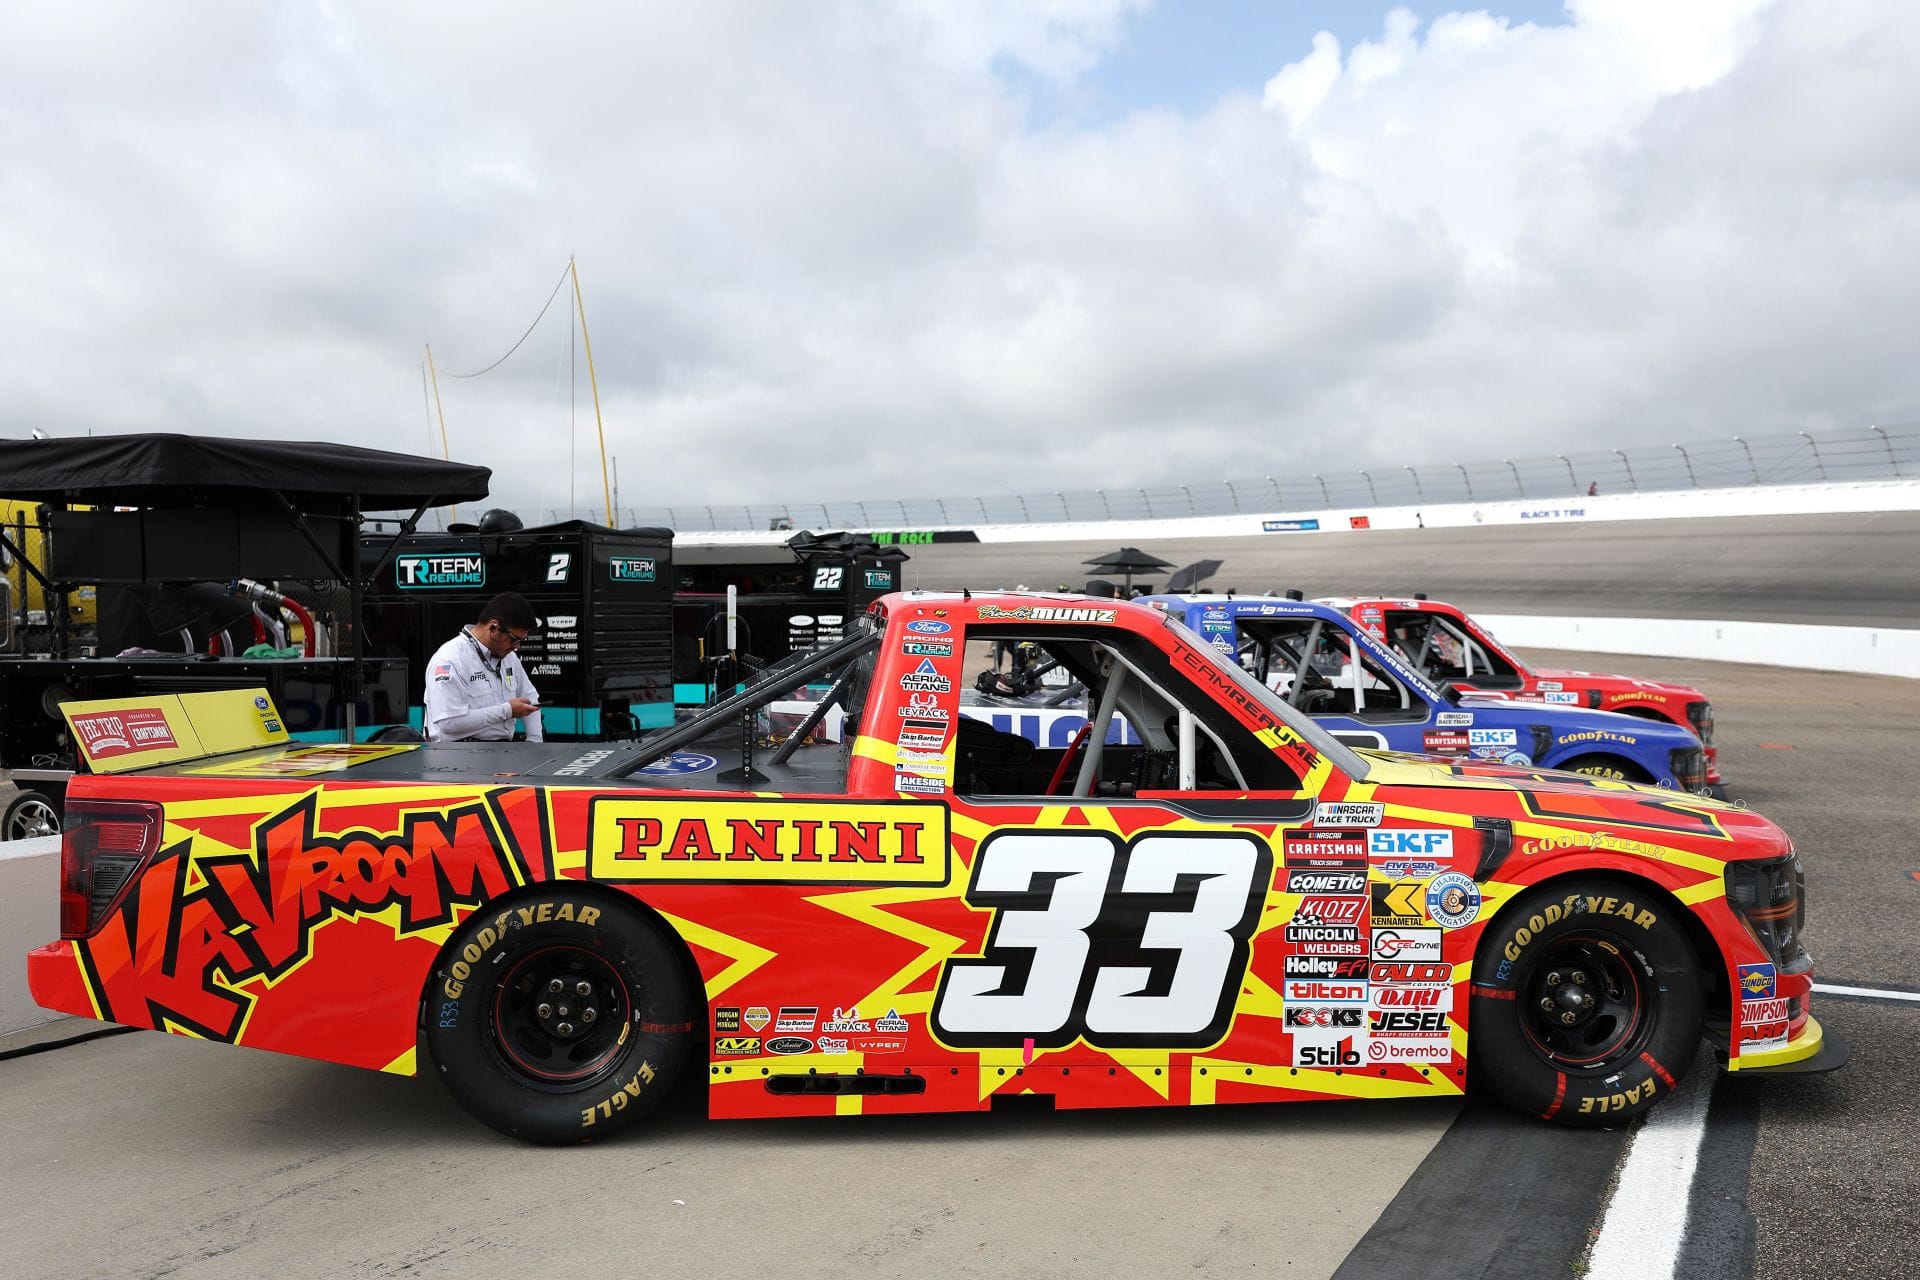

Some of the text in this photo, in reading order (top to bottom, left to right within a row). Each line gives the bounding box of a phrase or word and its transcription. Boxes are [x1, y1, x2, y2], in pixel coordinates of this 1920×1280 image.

[1520, 509, 1586, 519] BLACK'S TIRE
[871, 531, 934, 544] THE ROCK
[429, 558, 482, 573] TEAM
[547, 553, 570, 582] 2
[627, 560, 654, 572] TEAM
[429, 573, 482, 584] REAUME
[813, 567, 843, 589] 22
[1029, 607, 1118, 623] MUNIZ
[914, 621, 943, 632] Ford
[922, 644, 951, 652] TEAM
[1355, 629, 1441, 703] TEAMREAUME
[902, 674, 950, 684] AERIAL
[902, 682, 949, 692] TITANS
[1173, 640, 1322, 770] TEAMREAUME
[1547, 694, 1576, 702] SKF
[1610, 691, 1667, 703] GOODYEAR
[899, 708, 947, 718] LEVRACK
[74, 716, 126, 744] THE TRIP
[132, 726, 170, 741] CRAFTSMAN
[900, 733, 916, 741] Skip
[1471, 731, 1514, 744] SKF
[1558, 730, 1637, 745] GOODYEAR
[1425, 737, 1467, 745] CRAFTSMAN
[553, 750, 616, 776] RACING
[895, 774, 945, 791] LAKESIDE
[1335, 805, 1375, 815] NASCAR
[615, 816, 925, 865] PANINI
[1371, 833, 1449, 853] SKF
[1522, 831, 1666, 860] GOODYEAR
[1288, 843, 1363, 855] CRAFTSMAN
[1385, 862, 1437, 870] FIVE STAR
[1289, 875, 1365, 890] COMETIC
[1432, 875, 1475, 892] CHAMPION
[1303, 900, 1360, 918] KLOTZ
[1432, 907, 1475, 926] IRRIGATION
[1371, 917, 1424, 926] KENNAMETAL
[1504, 894, 1657, 962] GOODYEAR
[937, 834, 1260, 1034] 33
[1289, 928, 1355, 942] LINCOLN
[444, 903, 601, 999] GOODYEAR
[1304, 944, 1362, 954] WELDERS
[1286, 957, 1337, 978] Holley
[1371, 963, 1452, 982] CALICO
[1740, 977, 1773, 988] SUNOCO
[1290, 983, 1363, 999] tilton
[1379, 988, 1443, 1006] DART
[1285, 1007, 1364, 1028] KOOKS
[1741, 1000, 1788, 1021] SIMPSON
[823, 1023, 869, 1031] LEVRACK
[1371, 1012, 1449, 1031] JESEL
[1740, 1021, 1788, 1041] ARP
[1299, 1038, 1361, 1066] Stilo
[1390, 1045, 1449, 1058] brembo
[581, 1060, 657, 1128] EAGLE
[1578, 1076, 1658, 1113] EAGLE
